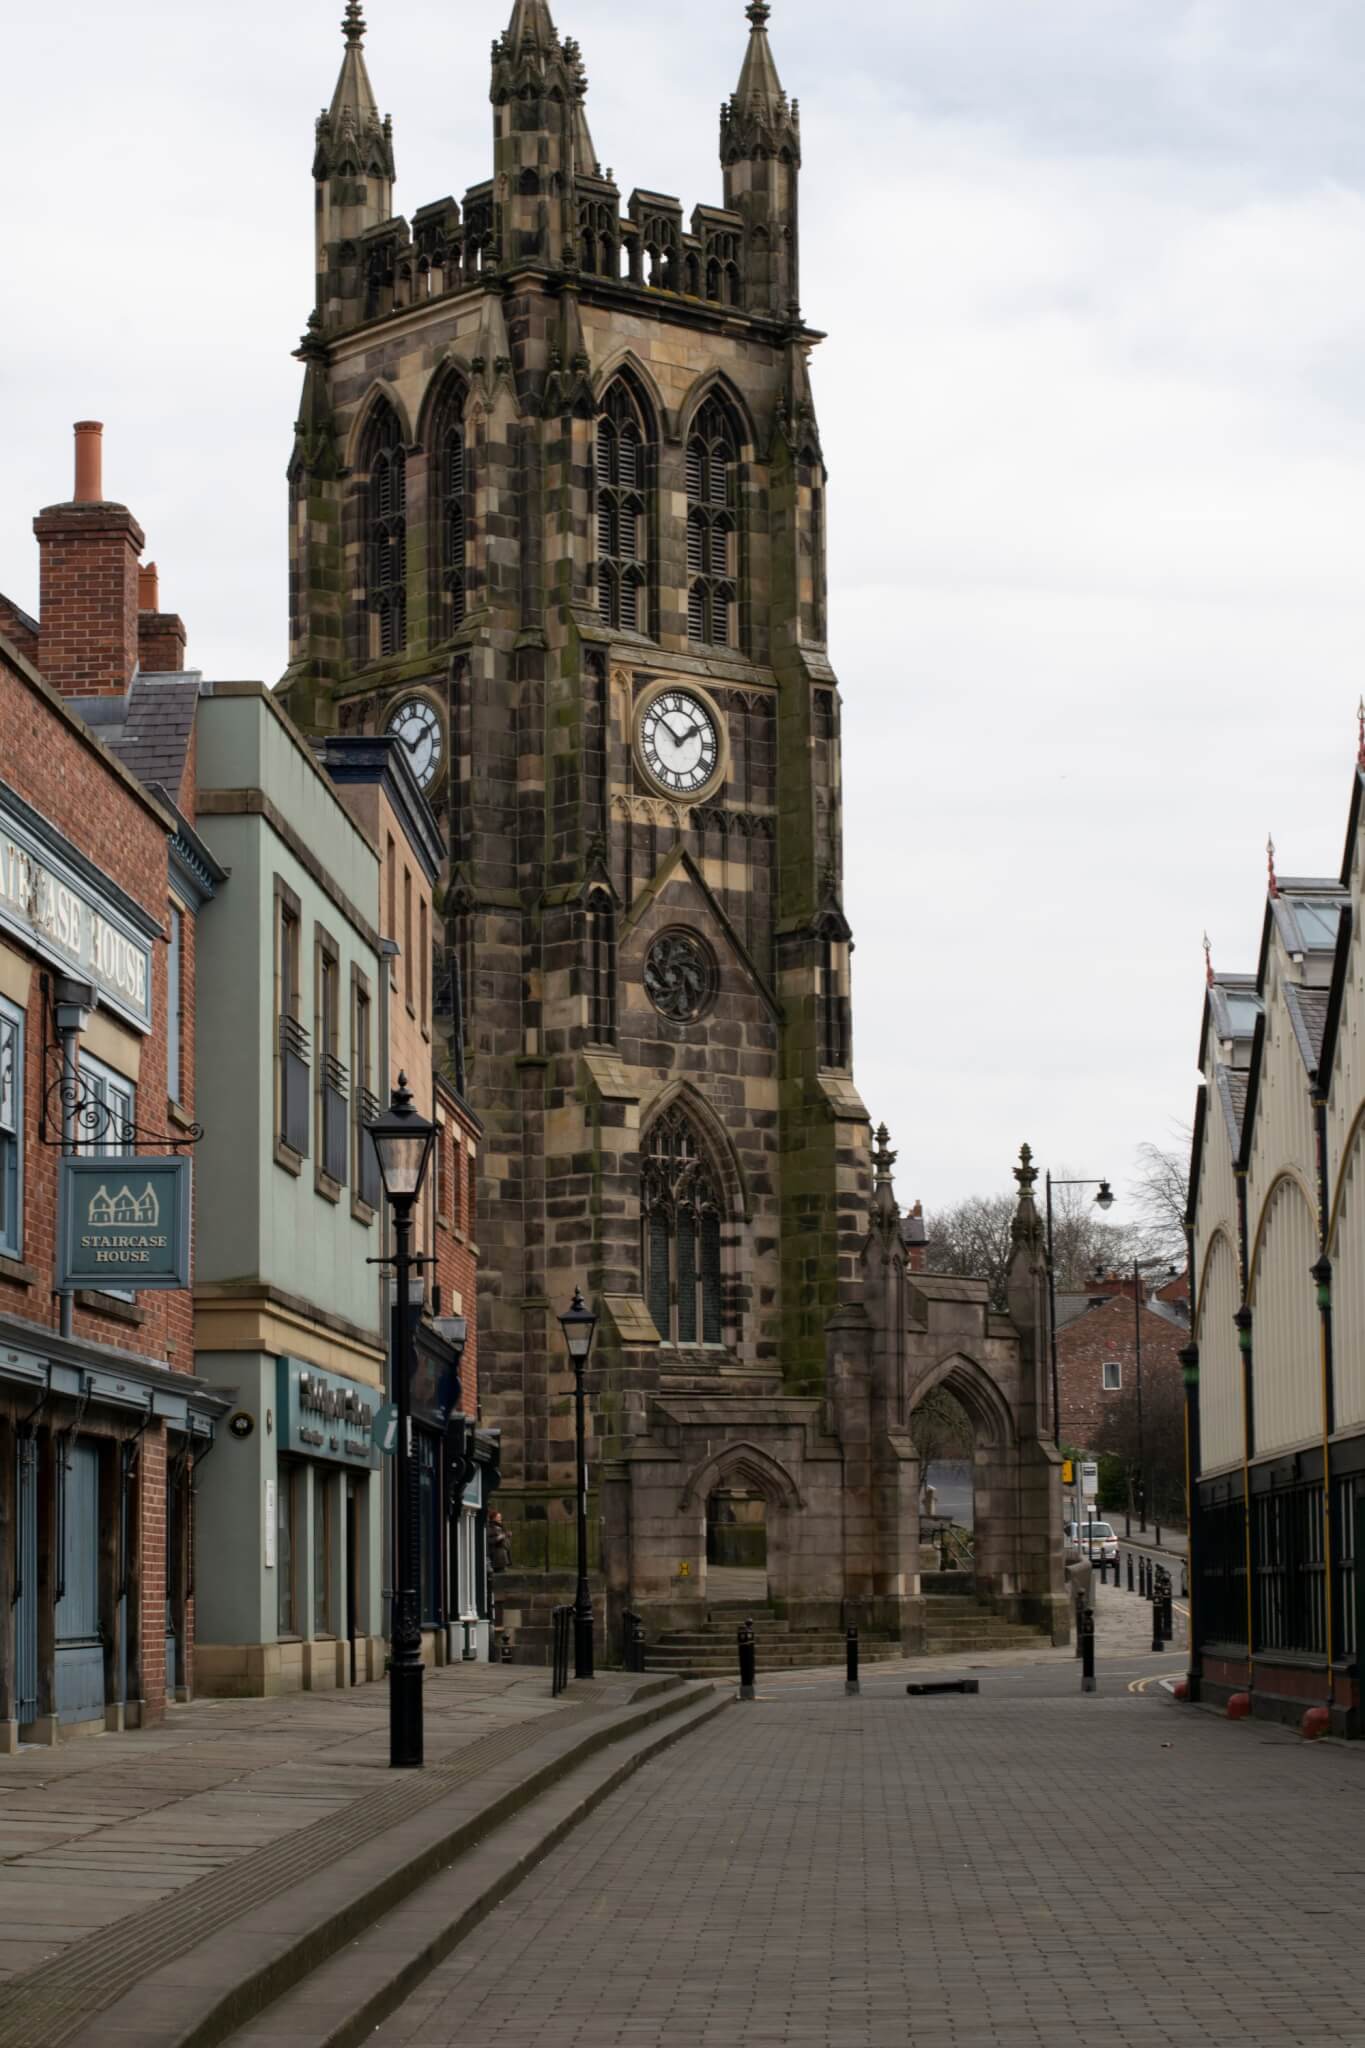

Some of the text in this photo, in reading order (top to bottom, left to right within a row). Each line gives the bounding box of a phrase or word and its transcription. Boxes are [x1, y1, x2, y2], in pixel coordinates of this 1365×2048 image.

[88, 912, 146, 1004] HOUSE
[81, 1235, 168, 1248] STAIRCASE
[95, 1250, 150, 1262] HOUSE
